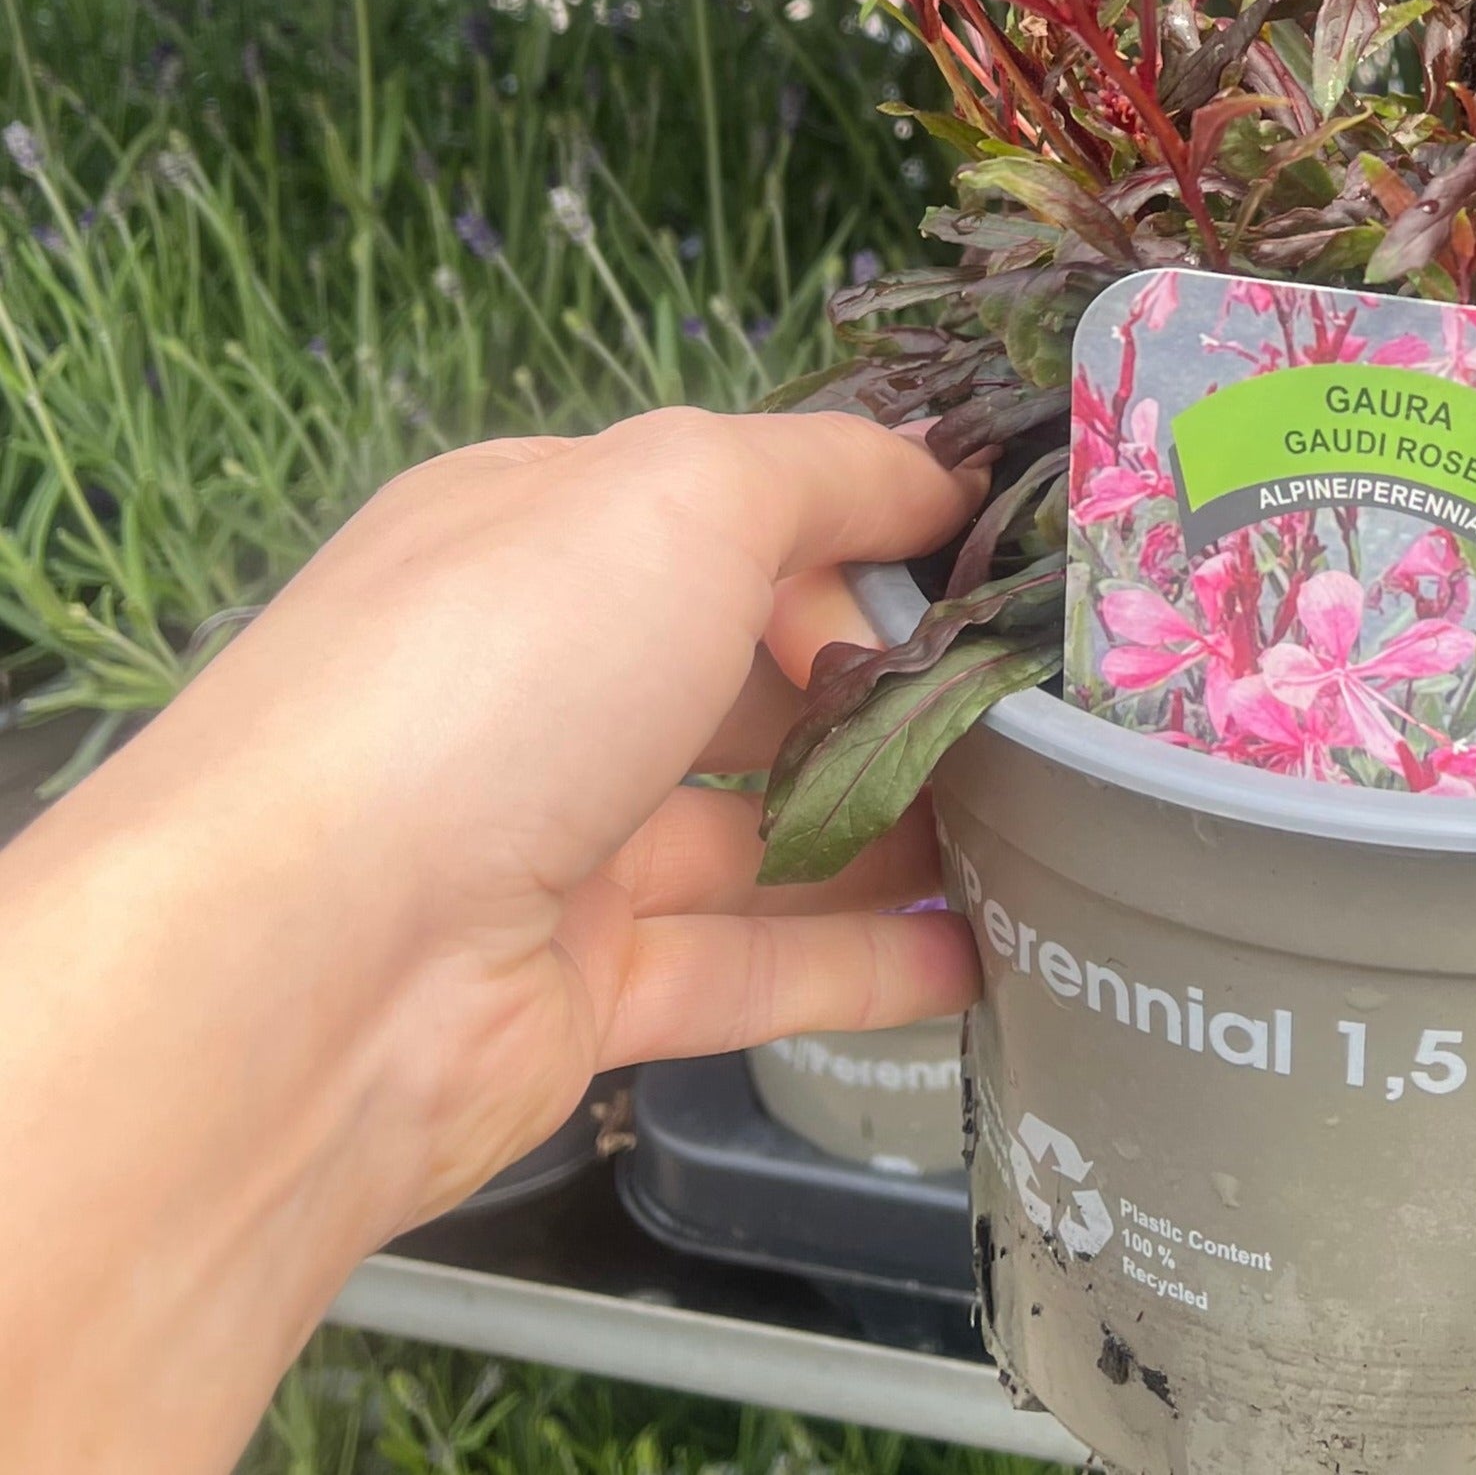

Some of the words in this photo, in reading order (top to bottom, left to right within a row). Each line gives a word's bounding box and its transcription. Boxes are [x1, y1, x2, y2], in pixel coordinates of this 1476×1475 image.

[1325, 385, 1453, 432] GAURA
[1284, 428, 1387, 457] GAUDI
[1337, 1020, 1468, 1101] 1,5
[1120, 1197, 1183, 1243] Plastic
[1188, 1230, 1273, 1271] Content
[1122, 1228, 1153, 1258] 100
[1157, 1244, 1176, 1270] %
[1122, 1255, 1208, 1310] Recycled
